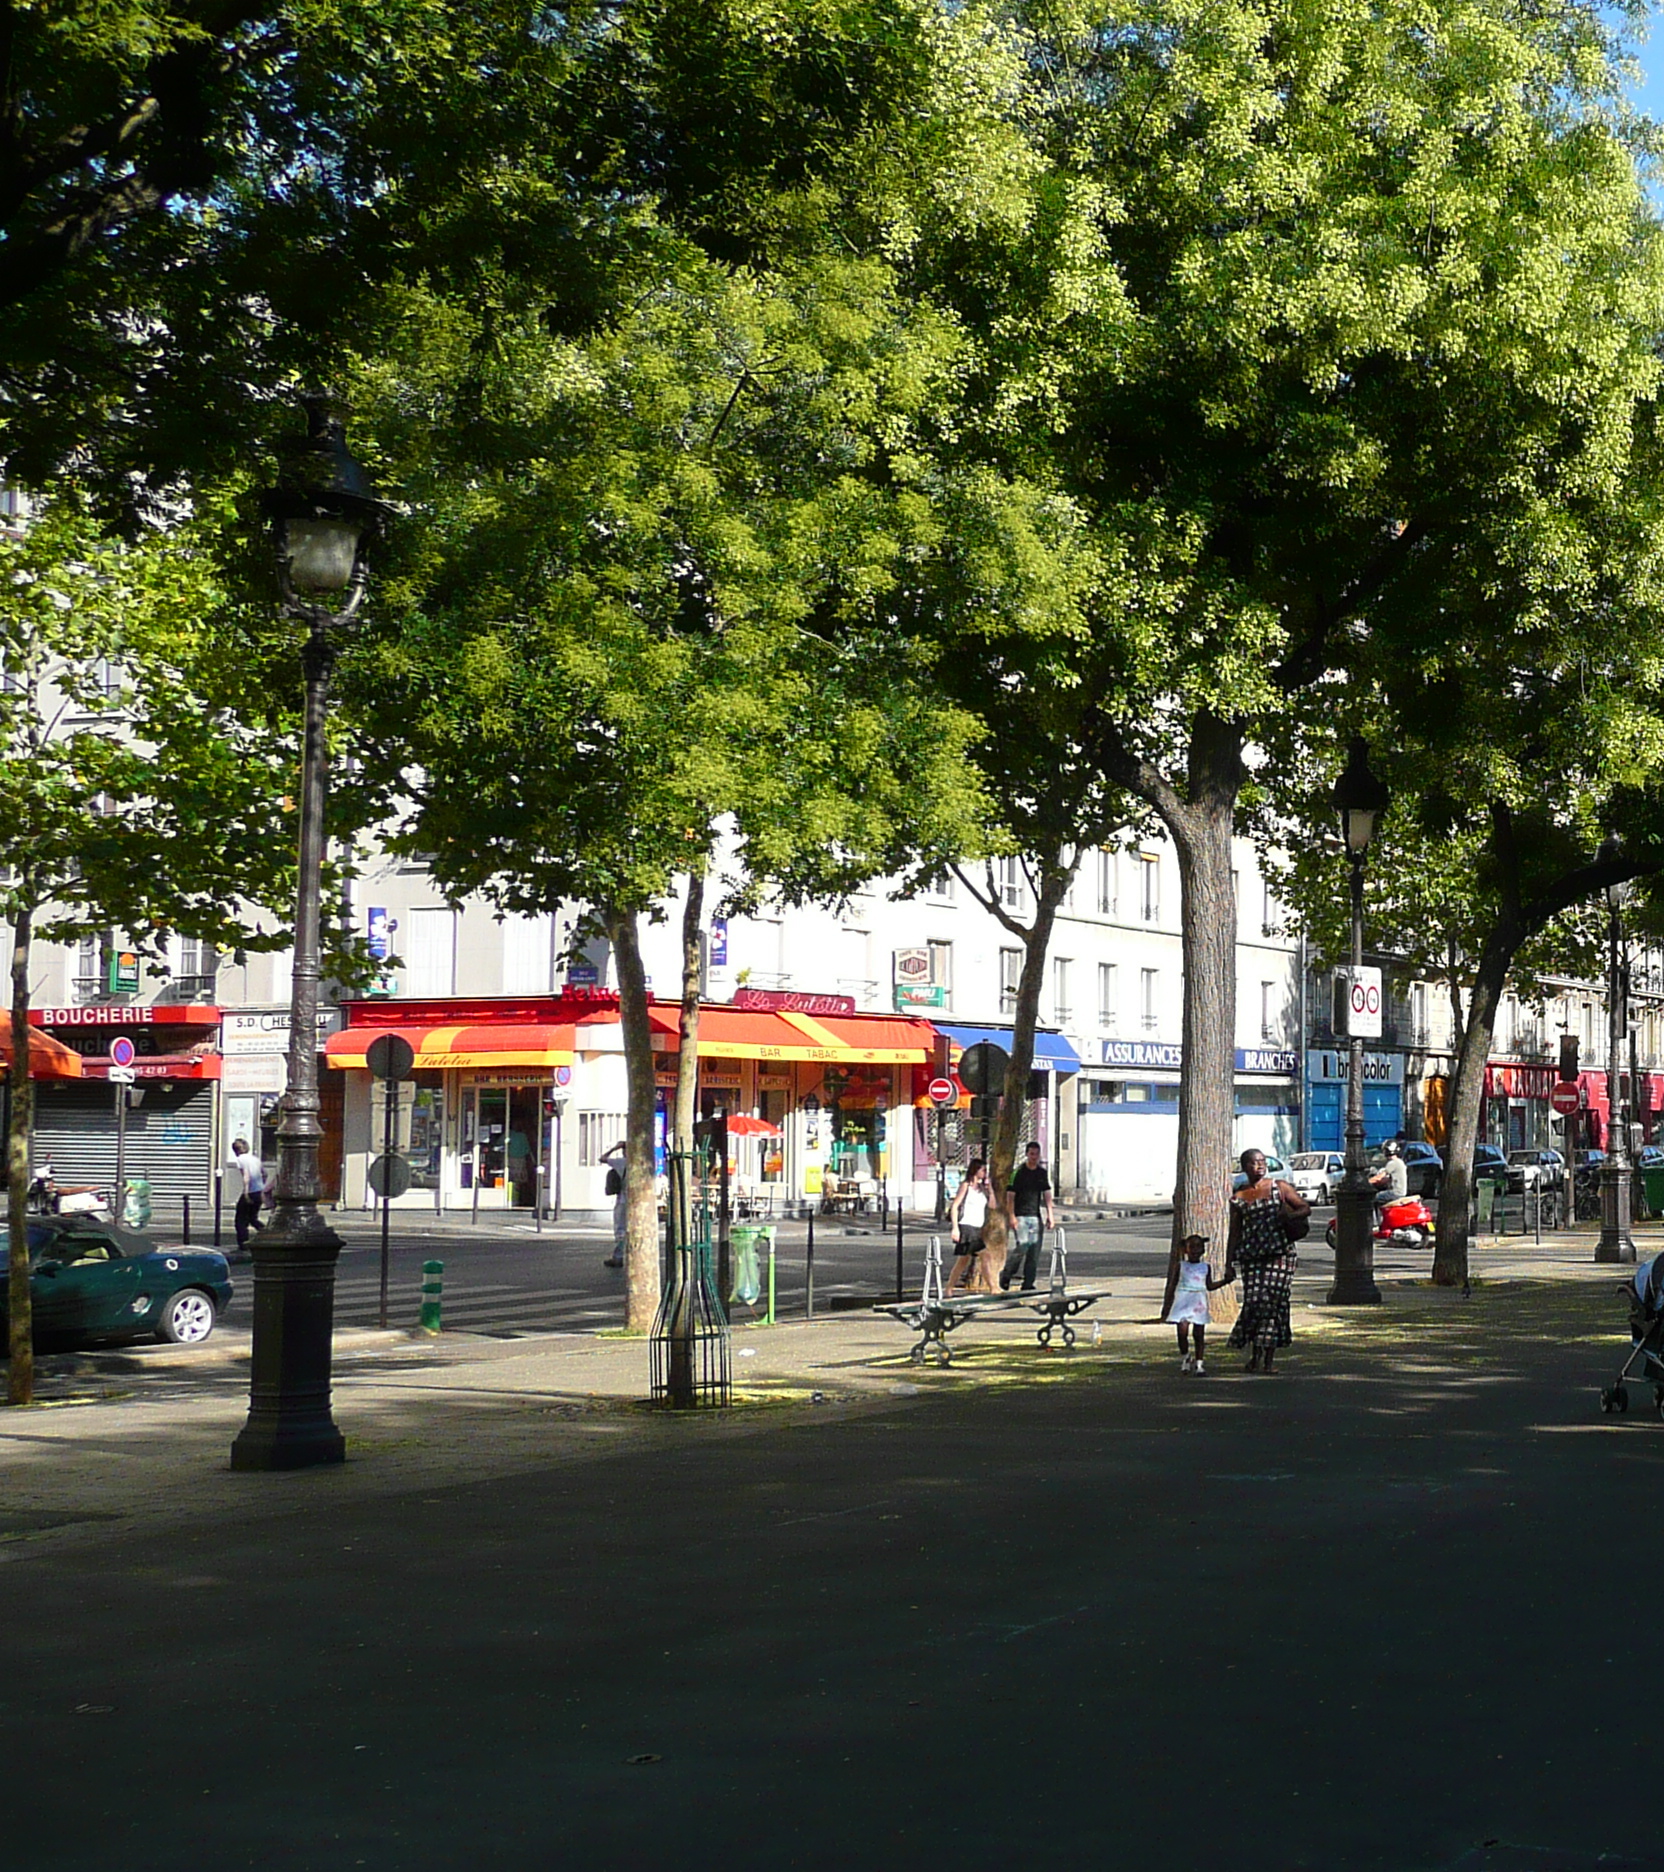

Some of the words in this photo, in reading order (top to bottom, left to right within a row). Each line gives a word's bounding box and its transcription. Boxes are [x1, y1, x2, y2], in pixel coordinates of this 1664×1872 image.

[913, 988, 936, 998] PMU
[43, 1007, 154, 1024] BOUCHERIE
[760, 1047, 782, 1058] BAR
[806, 1049, 838, 1060] TABAC
[1105, 1043, 1182, 1065] ASSURANCES
[1244, 1053, 1295, 1071] BRANCHES
